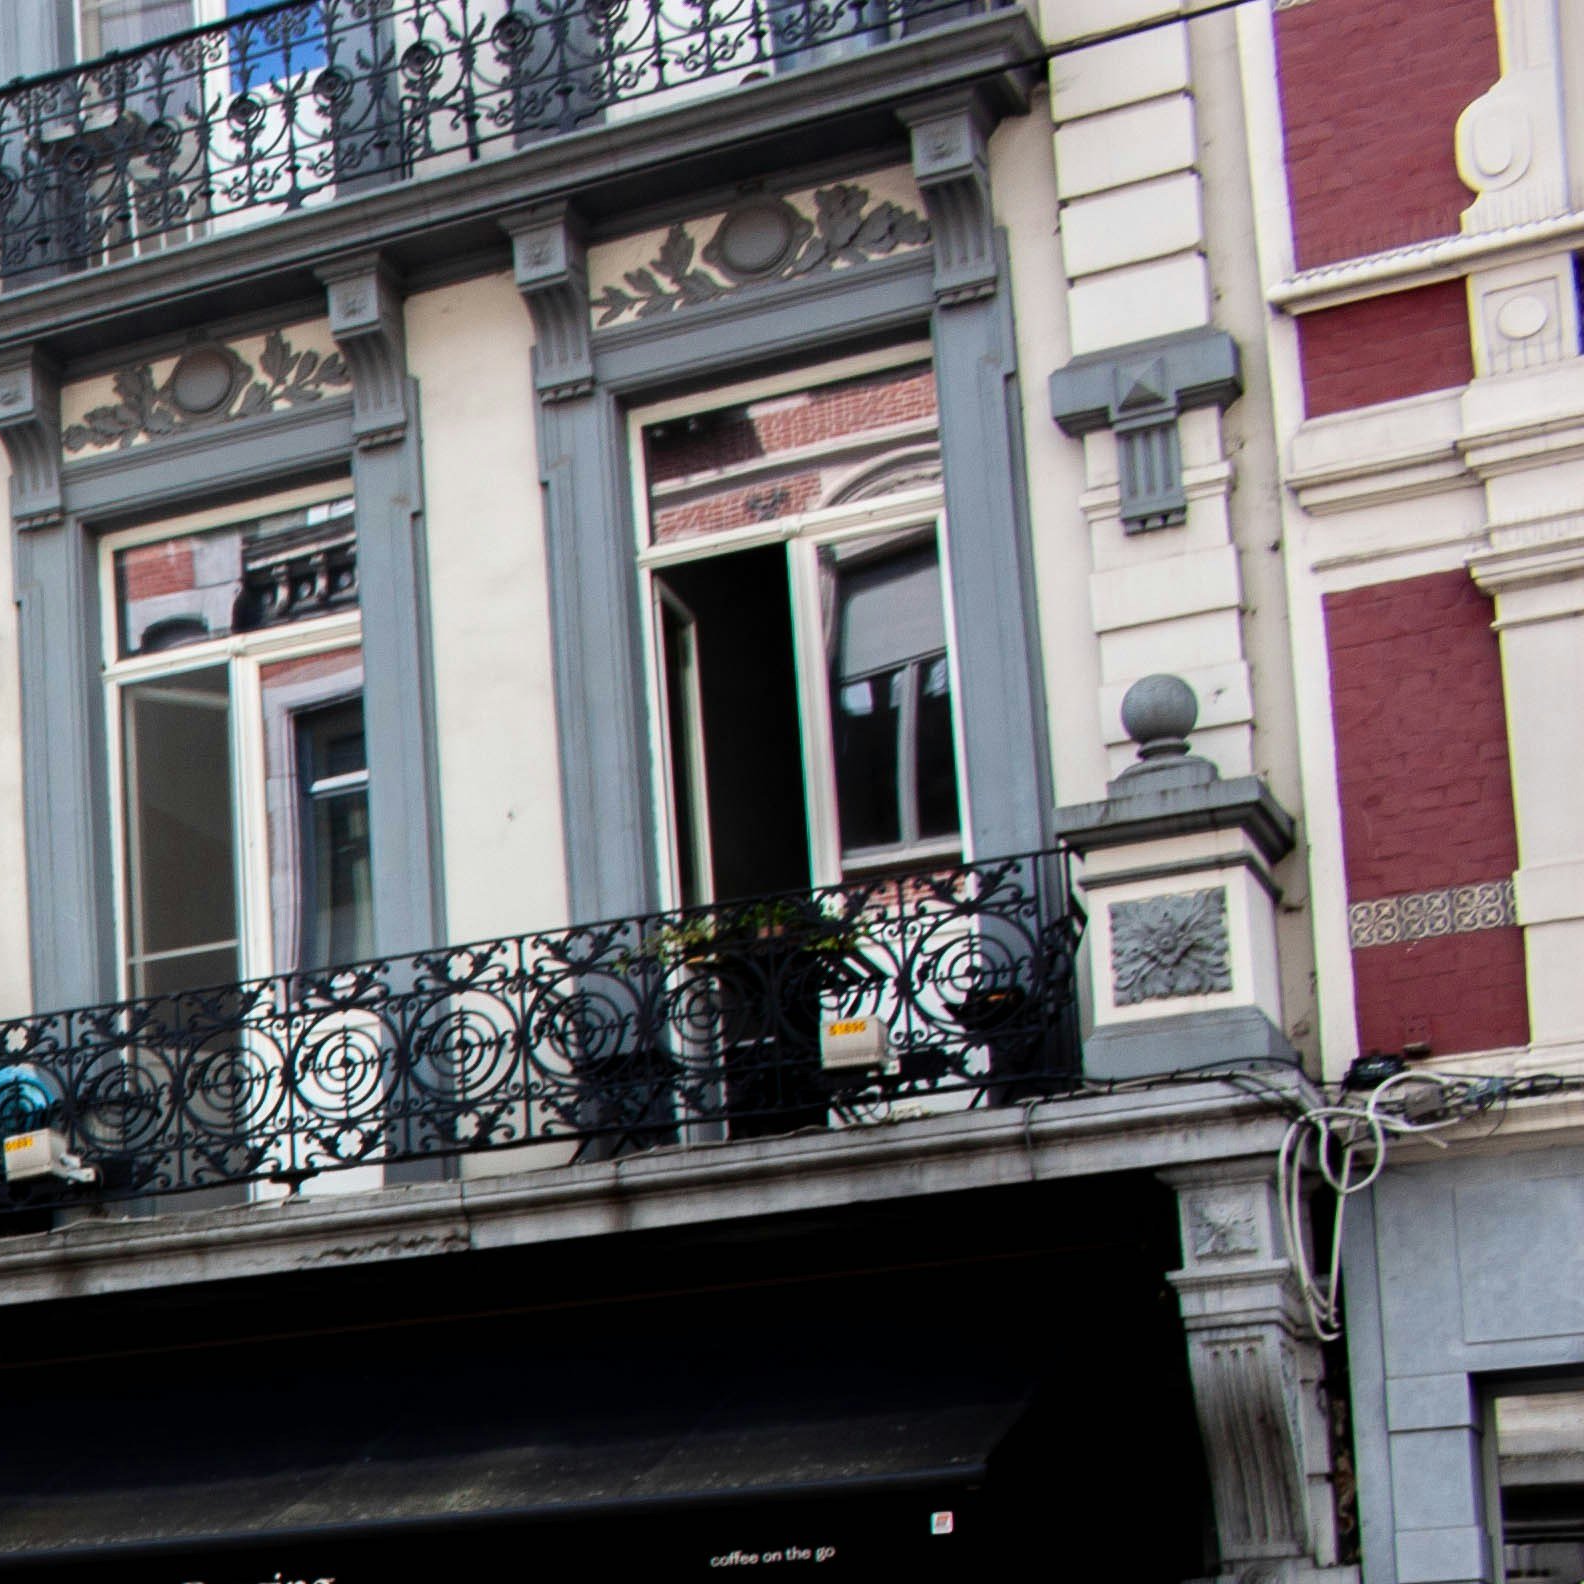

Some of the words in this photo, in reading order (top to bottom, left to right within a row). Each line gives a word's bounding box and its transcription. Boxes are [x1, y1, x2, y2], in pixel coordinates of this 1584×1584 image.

[710, 1551, 757, 1568] coffee
[762, 1549, 783, 1562] on
[785, 1546, 812, 1562] the
[815, 1546, 837, 1561] go
